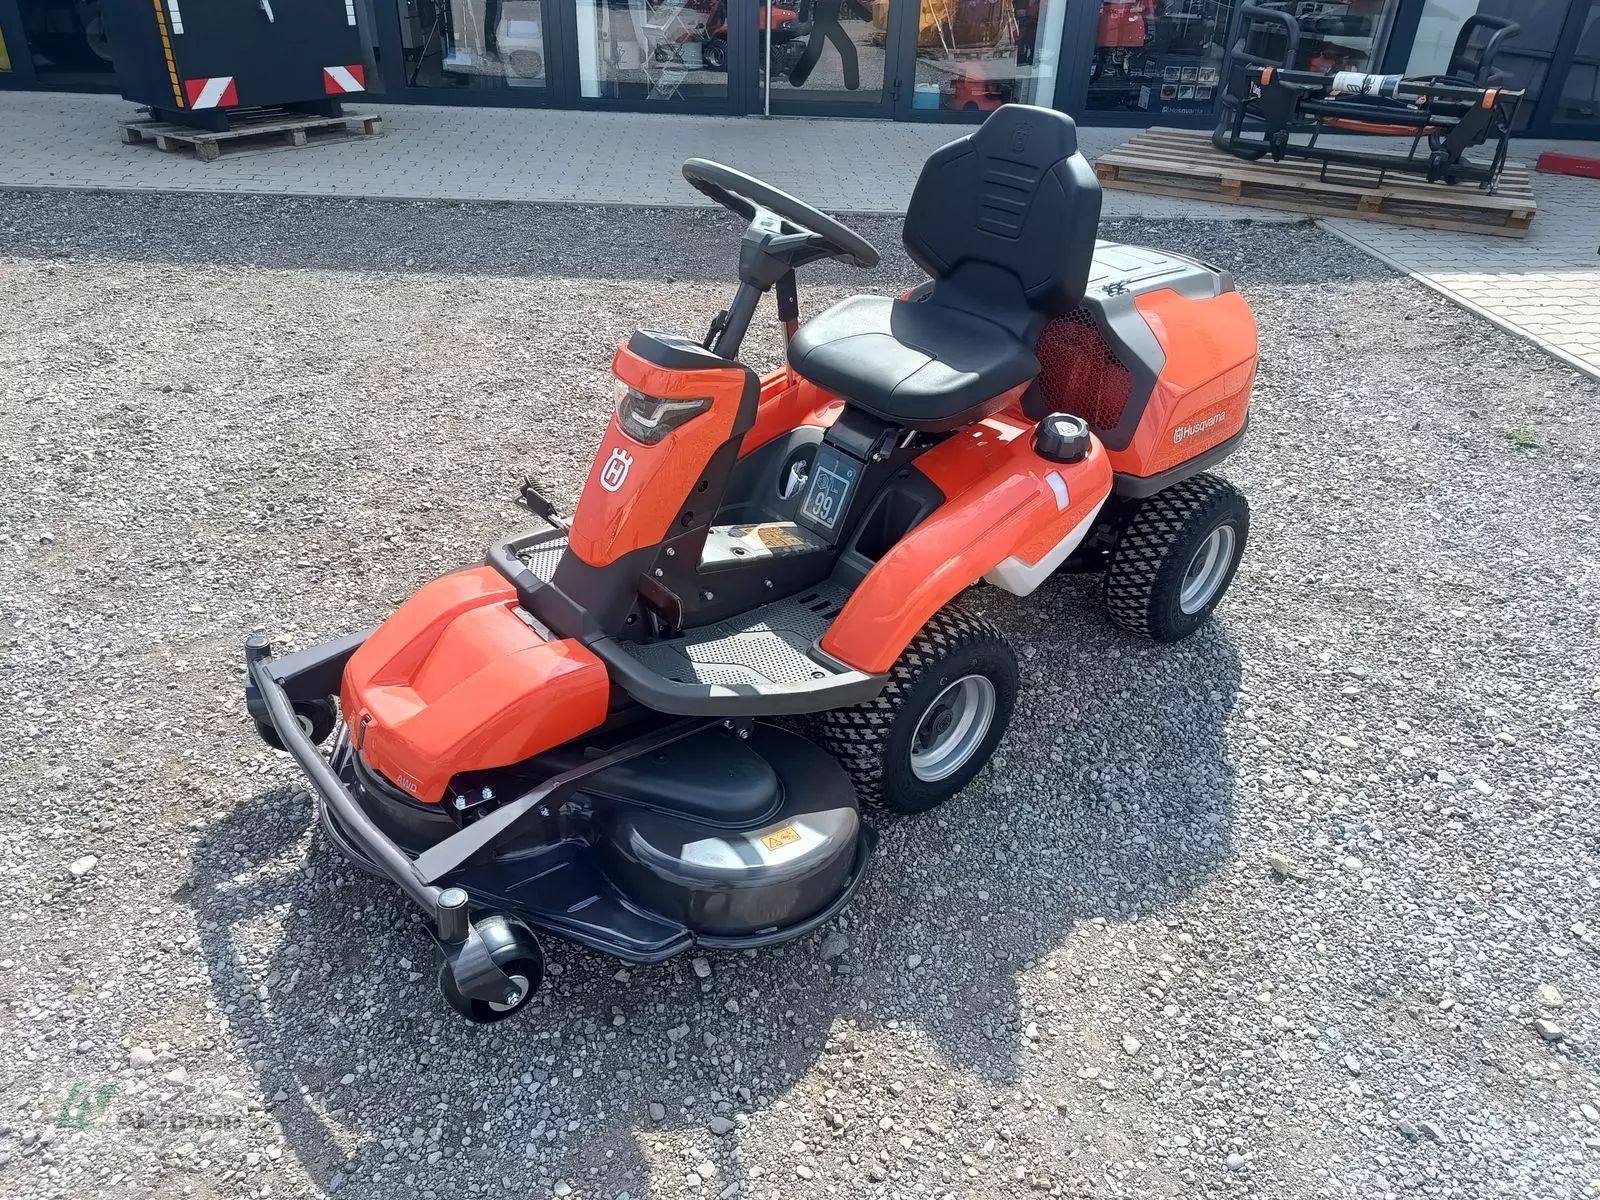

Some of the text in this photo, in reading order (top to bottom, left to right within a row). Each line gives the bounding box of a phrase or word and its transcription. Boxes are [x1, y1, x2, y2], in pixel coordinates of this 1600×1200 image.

[1183, 411, 1227, 439] Husqvarna
[812, 491, 833, 520] 99
[396, 774, 418, 793] AWD
